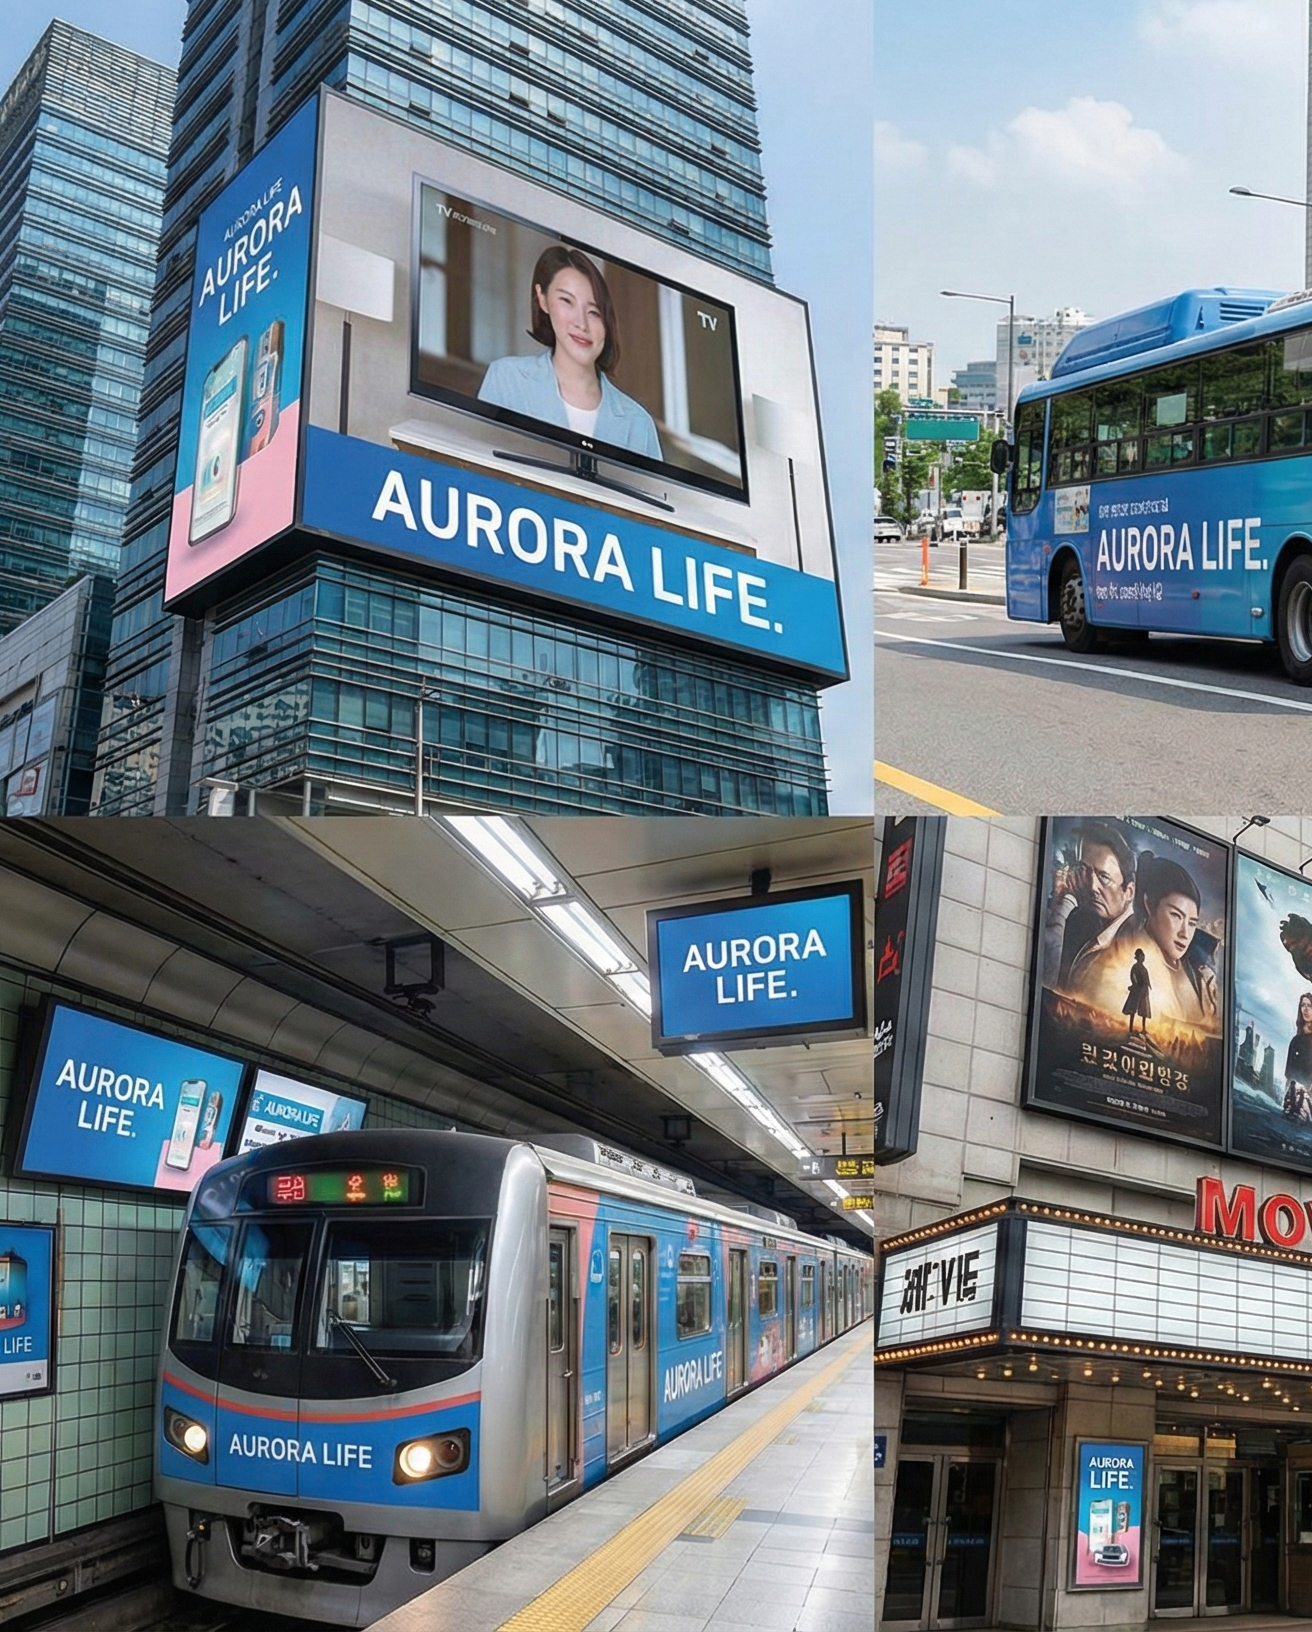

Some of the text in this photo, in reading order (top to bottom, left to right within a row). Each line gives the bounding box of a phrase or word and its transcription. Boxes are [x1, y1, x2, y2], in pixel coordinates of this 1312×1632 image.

[199, 185, 302, 307] AURORA
[219, 251, 278, 326] LIFE.
[697, 310, 718, 331] TV
[372, 470, 783, 634] AURORA LIFE.
[1097, 517, 1268, 571] AURORA LIFE.
[683, 929, 827, 973] AURORA
[716, 970, 797, 1004] LIFE.
[56, 1059, 164, 1110] AURORA
[78, 1100, 136, 1138] LIFE.
[4, 1336, 32, 1354] LIFE
[664, 1358, 703, 1403] AURORA
[229, 1434, 372, 1469] AURORA LIFE
[1089, 1456, 1134, 1469] AURORA
[1090, 1470, 1133, 1489] LIFE.
